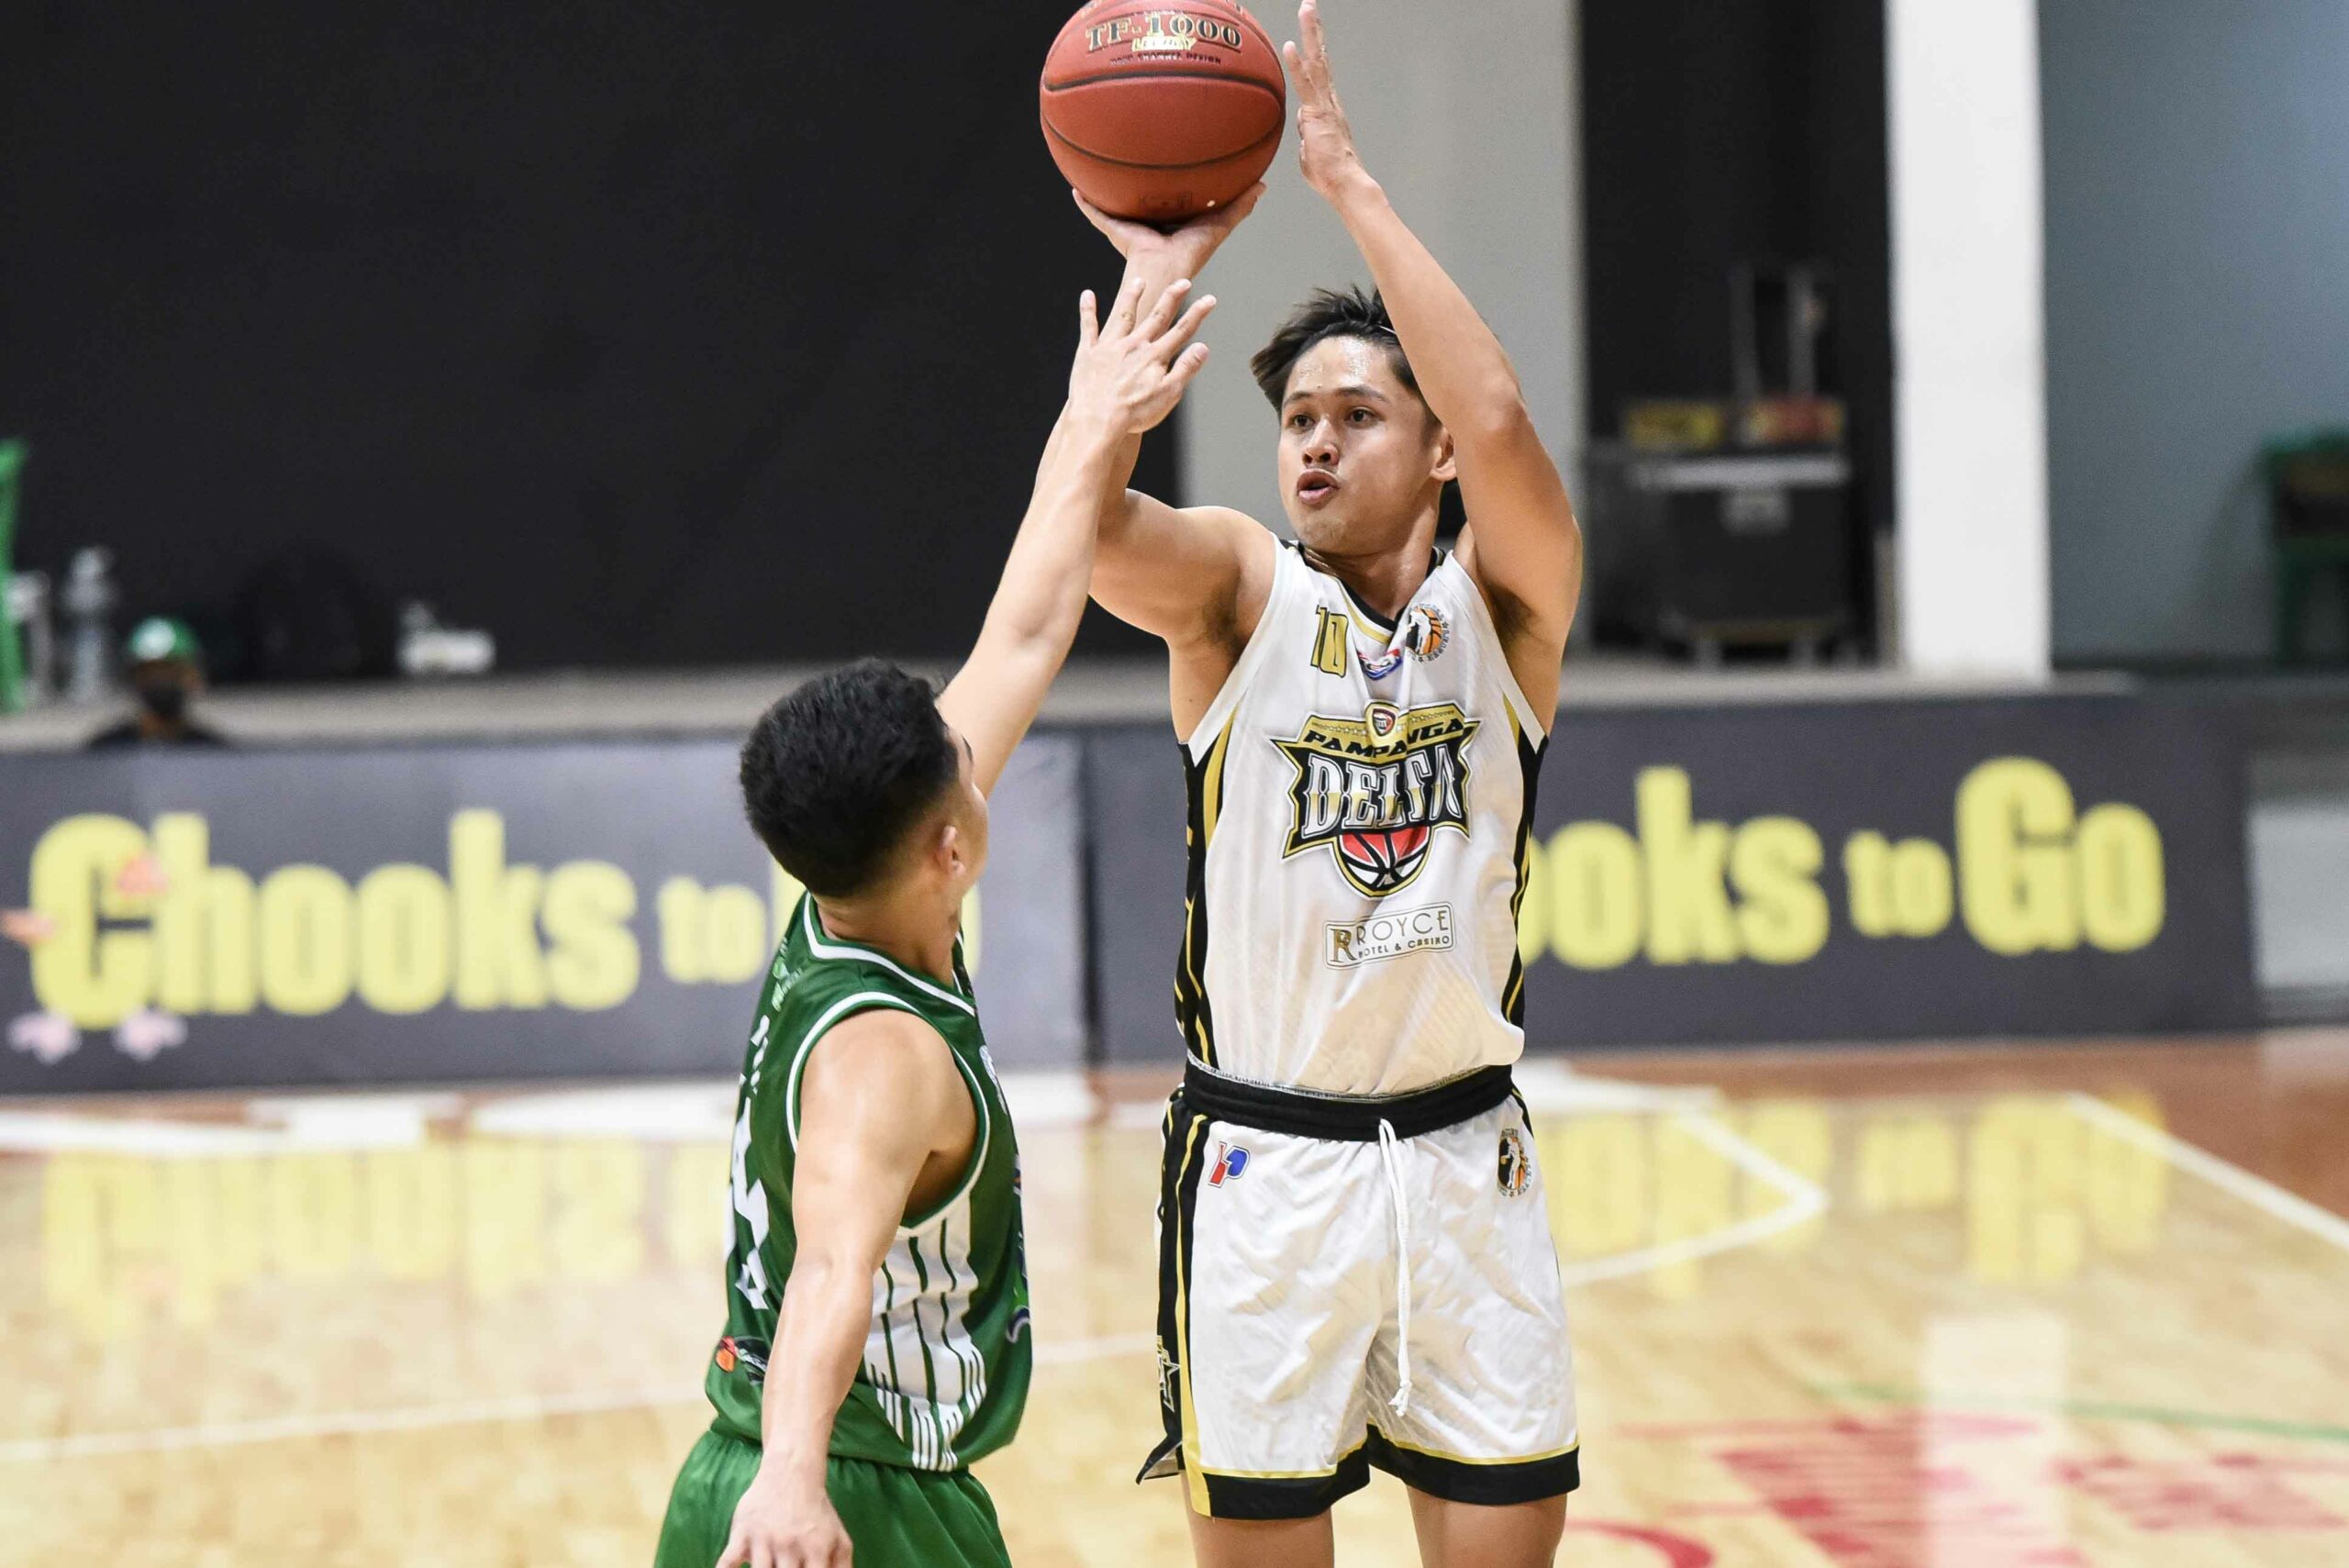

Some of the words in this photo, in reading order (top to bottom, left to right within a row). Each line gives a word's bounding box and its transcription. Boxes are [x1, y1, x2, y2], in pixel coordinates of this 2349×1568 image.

[1301, 742, 1464, 840] DELTA
[1843, 829, 1954, 939] to
[1954, 755, 2166, 957] Go
[28, 807, 640, 1029] Chooks
[657, 873, 767, 984] to
[1356, 910, 1450, 946] ROYCE
[1394, 942, 1402, 952] &
